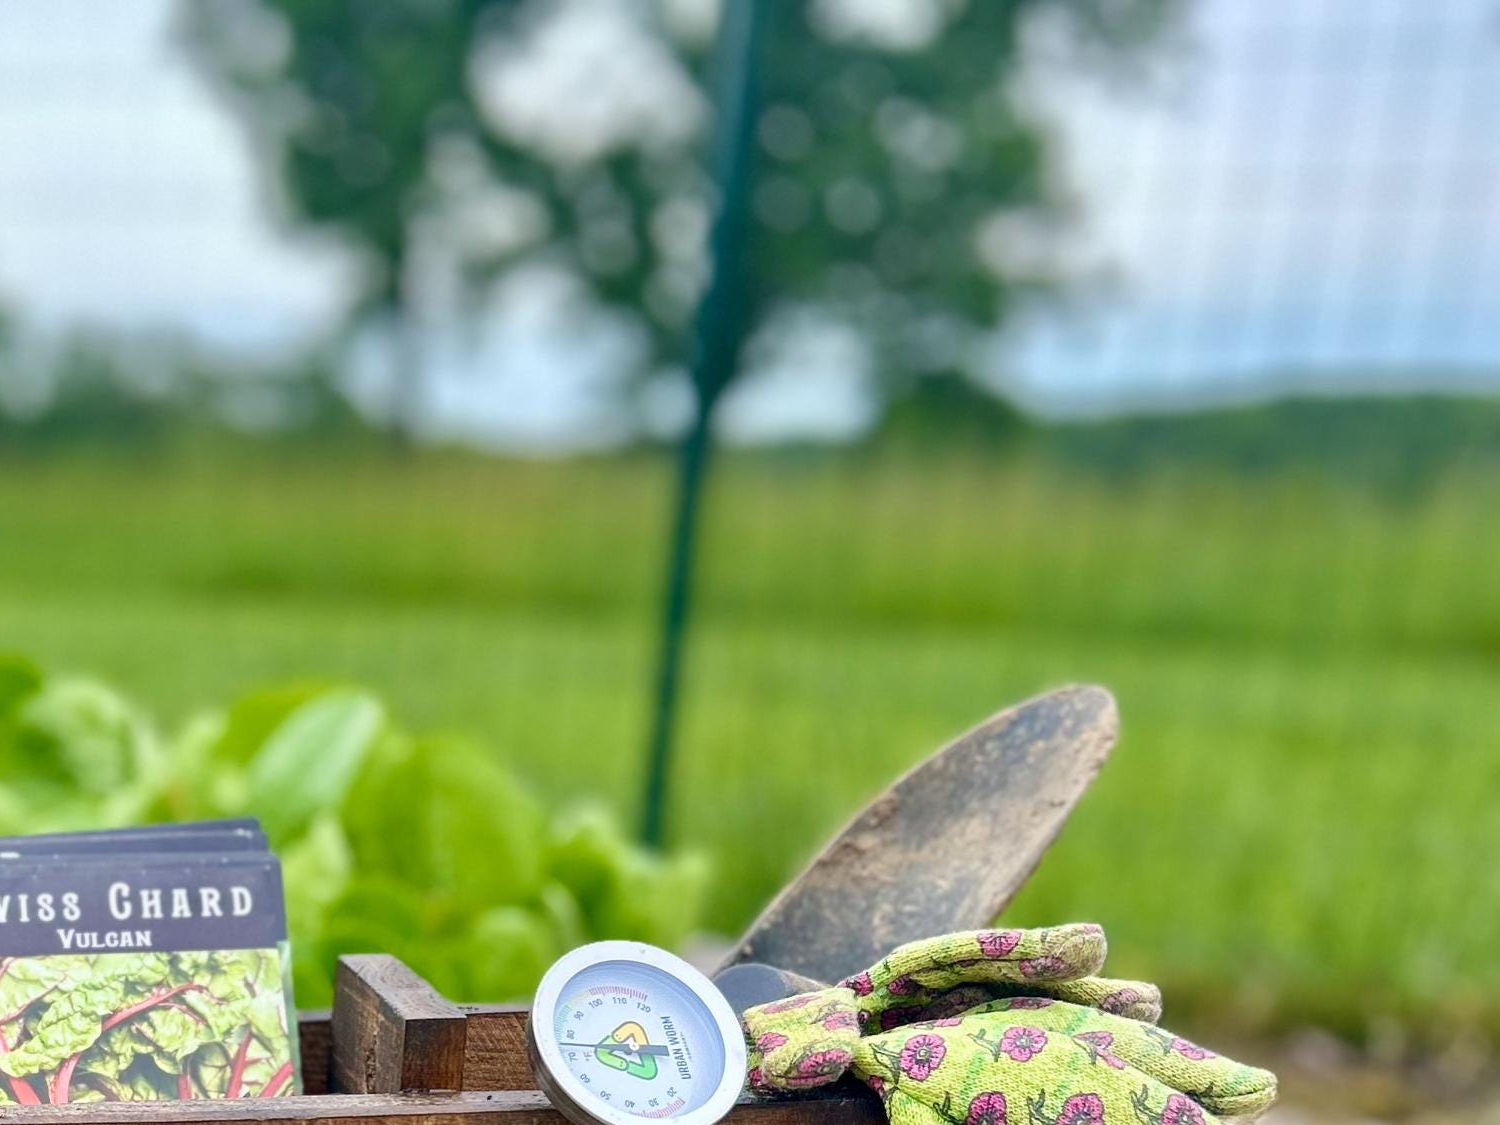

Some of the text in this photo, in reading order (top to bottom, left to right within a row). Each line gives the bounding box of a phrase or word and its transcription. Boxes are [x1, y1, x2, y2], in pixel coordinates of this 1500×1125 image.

[589, 998, 603, 1009] 100
[612, 997, 627, 1006] 110
[636, 1002, 651, 1014] 120
[661, 1016, 691, 1080] URBAN WORM
[568, 1052, 577, 1062] 70
[600, 1090, 612, 1101] 50
[625, 1099, 635, 1108] 40
